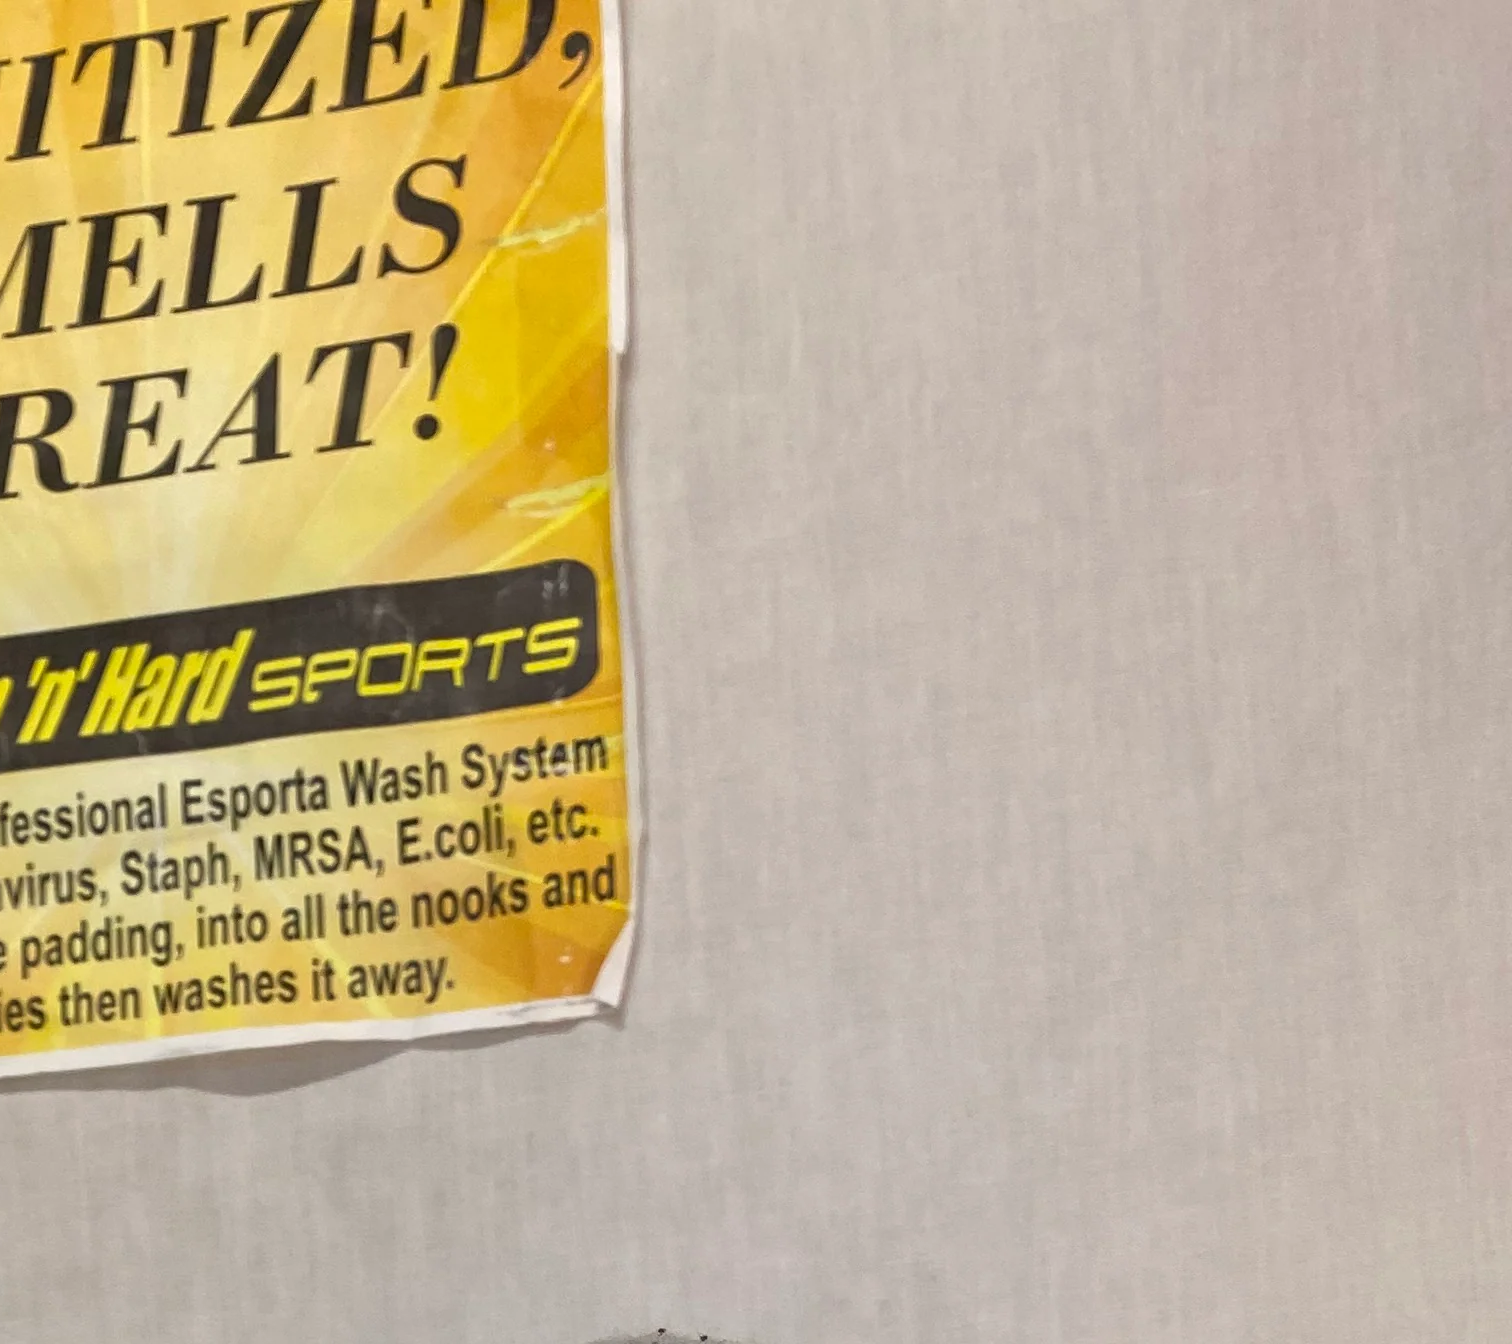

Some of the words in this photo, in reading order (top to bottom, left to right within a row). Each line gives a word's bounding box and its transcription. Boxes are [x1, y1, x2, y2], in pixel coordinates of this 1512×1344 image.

[83, 627, 256, 737] Hard
[248, 615, 584, 713] SPORTS
[180, 768, 329, 832] Esporta
[339, 750, 448, 807] Wash
[461, 735, 608, 797] System
[120, 842, 241, 899] Staph,
[254, 825, 385, 881] MRSA,
[396, 802, 516, 866] E.coli,
[527, 799, 600, 843] etc.
[20, 919, 186, 980] padding,
[196, 906, 268, 950] into
[281, 894, 326, 941] all
[336, 889, 399, 938] the
[411, 872, 530, 929] nooks
[541, 853, 616, 908] and
[57, 982, 141, 1026] then
[154, 963, 298, 1014] washes
[312, 957, 337, 1001] it
[347, 955, 455, 1002] away.
